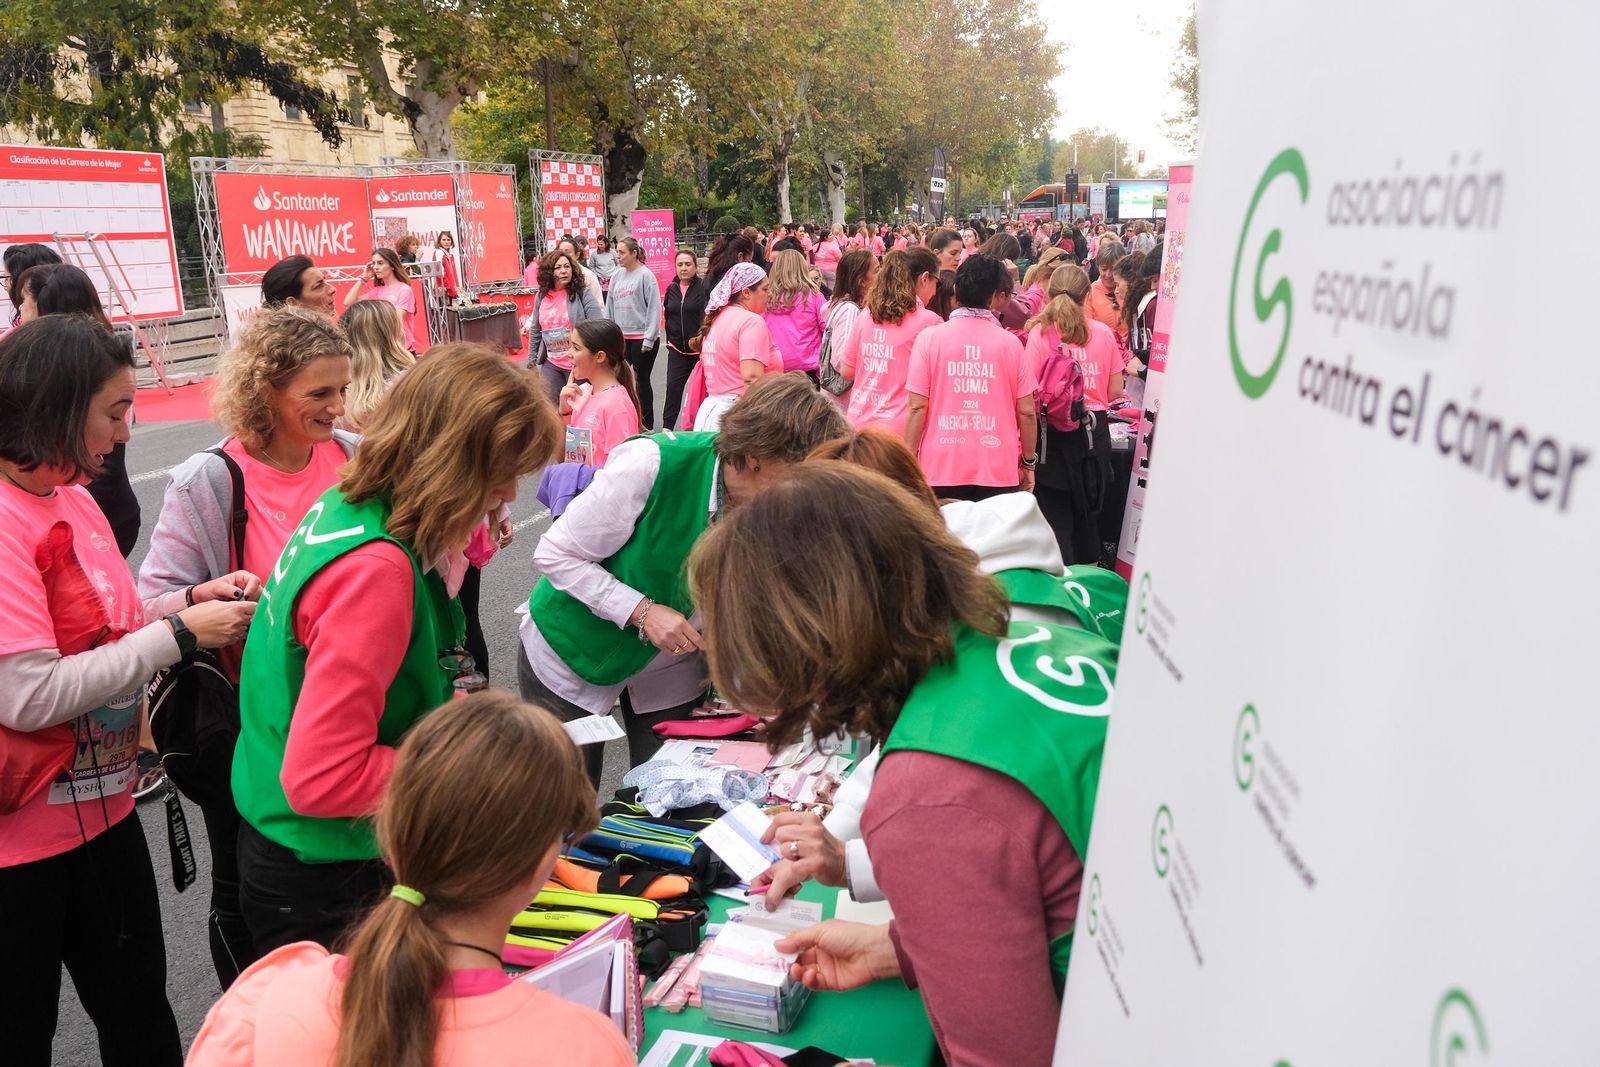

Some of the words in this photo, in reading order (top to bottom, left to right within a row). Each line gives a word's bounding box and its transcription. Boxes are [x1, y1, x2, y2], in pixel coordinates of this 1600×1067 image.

[10, 154, 50, 165] Clasificación
[51, 158, 58, 166] de
[59, 158, 66, 166] la
[66, 158, 89, 167] Carrera
[90, 159, 98, 167] de
[98, 159, 104, 167] la
[105, 160, 122, 169] Mujer
[391, 188, 449, 202] Santander
[1326, 150, 1505, 230] asociación
[273, 191, 340, 211] Santander
[242, 218, 356, 260] WANAWAKE
[1312, 261, 1457, 340] española
[873, 328, 887, 342] TU
[861, 342, 896, 360] DORSAL
[963, 344, 980, 360] TU
[1071, 348, 1087, 361] TU
[864, 357, 889, 375] SUMA
[947, 361, 996, 379] DORSAL
[953, 378, 989, 395] SUMA
[962, 400, 979, 409] 2024
[937, 415, 969, 430] VALENCIA
[973, 415, 996, 430] SEVILLA
[1298, 354, 1382, 427] contra
[1388, 370, 1431, 446] el
[1435, 385, 1590, 513] cáncer
[101, 765, 107, 773] DE
[108, 764, 116, 772] LA
